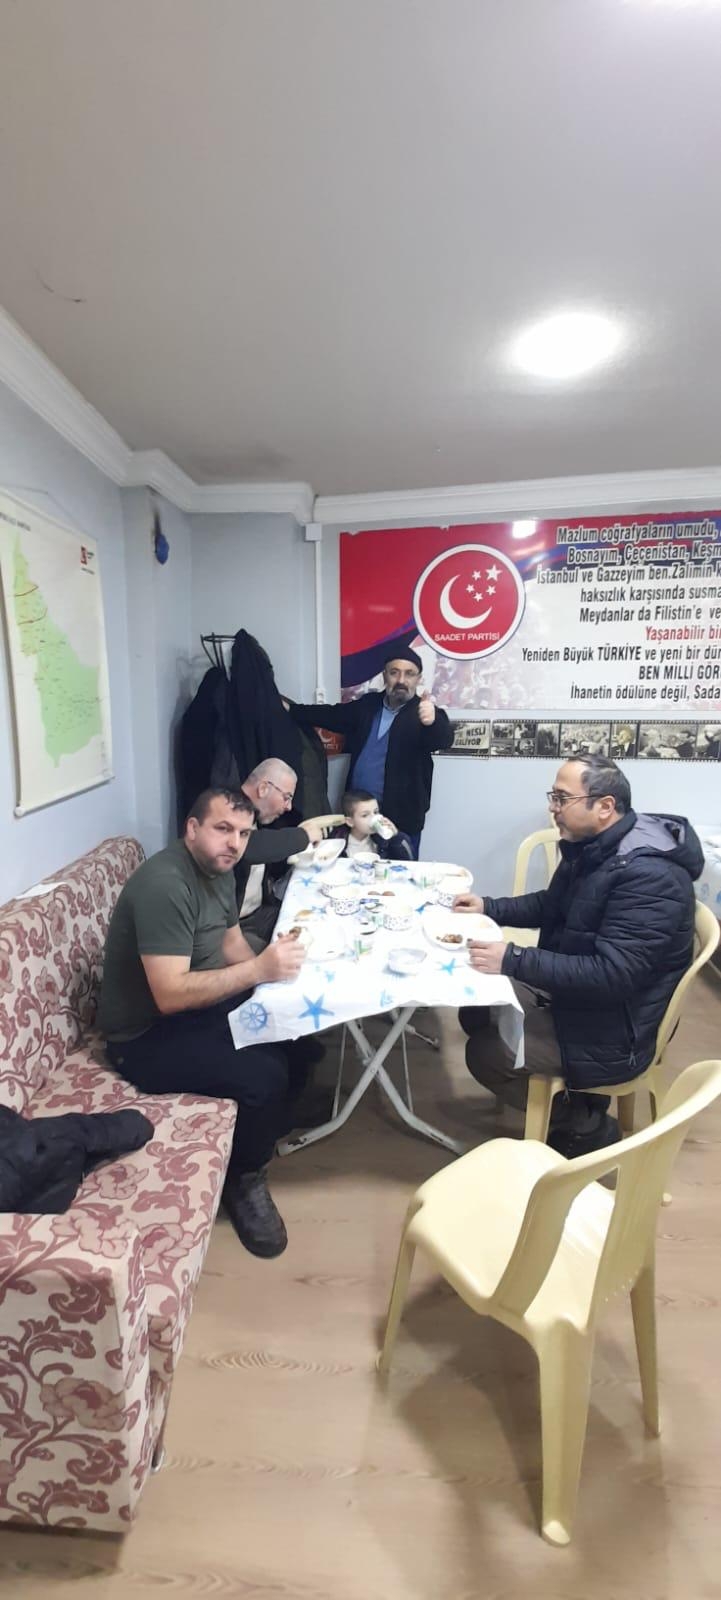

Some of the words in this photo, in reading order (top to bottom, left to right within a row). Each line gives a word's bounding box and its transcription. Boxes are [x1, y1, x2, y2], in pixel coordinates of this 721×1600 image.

[557, 526, 598, 543] Mazlum
[600, 523, 672, 543] coğrafyaların
[676, 520, 717, 539] umudu,
[568, 547, 621, 564] Bosnayım,
[624, 543, 689, 564] Çeçenistan,
[537, 565, 578, 583] İstanbul
[581, 571, 593, 582] ve
[597, 565, 645, 583] Gazzeyim
[580, 587, 626, 602] haksızlık
[630, 585, 685, 604] karşısında
[580, 607, 635, 625] Meydanlar
[638, 607, 650, 621] da
[654, 605, 702, 620] Filistin'e
[434, 633, 466, 641] SAADET
[467, 632, 500, 641] PARTİSİ
[645, 625, 705, 644] Yaşanabilir
[522, 647, 560, 661] Yeniden
[563, 647, 594, 664] Büyük
[597, 643, 642, 661] TÜRKİYE
[645, 649, 656, 661] ve
[659, 646, 682, 663] yeni
[686, 645, 700, 660] bir
[638, 665, 659, 680] BEN
[663, 662, 694, 680] MİLLİ
[697, 662, 721, 680] GÖR
[570, 681, 612, 699] İhanetin
[615, 684, 657, 699] ödülüne
